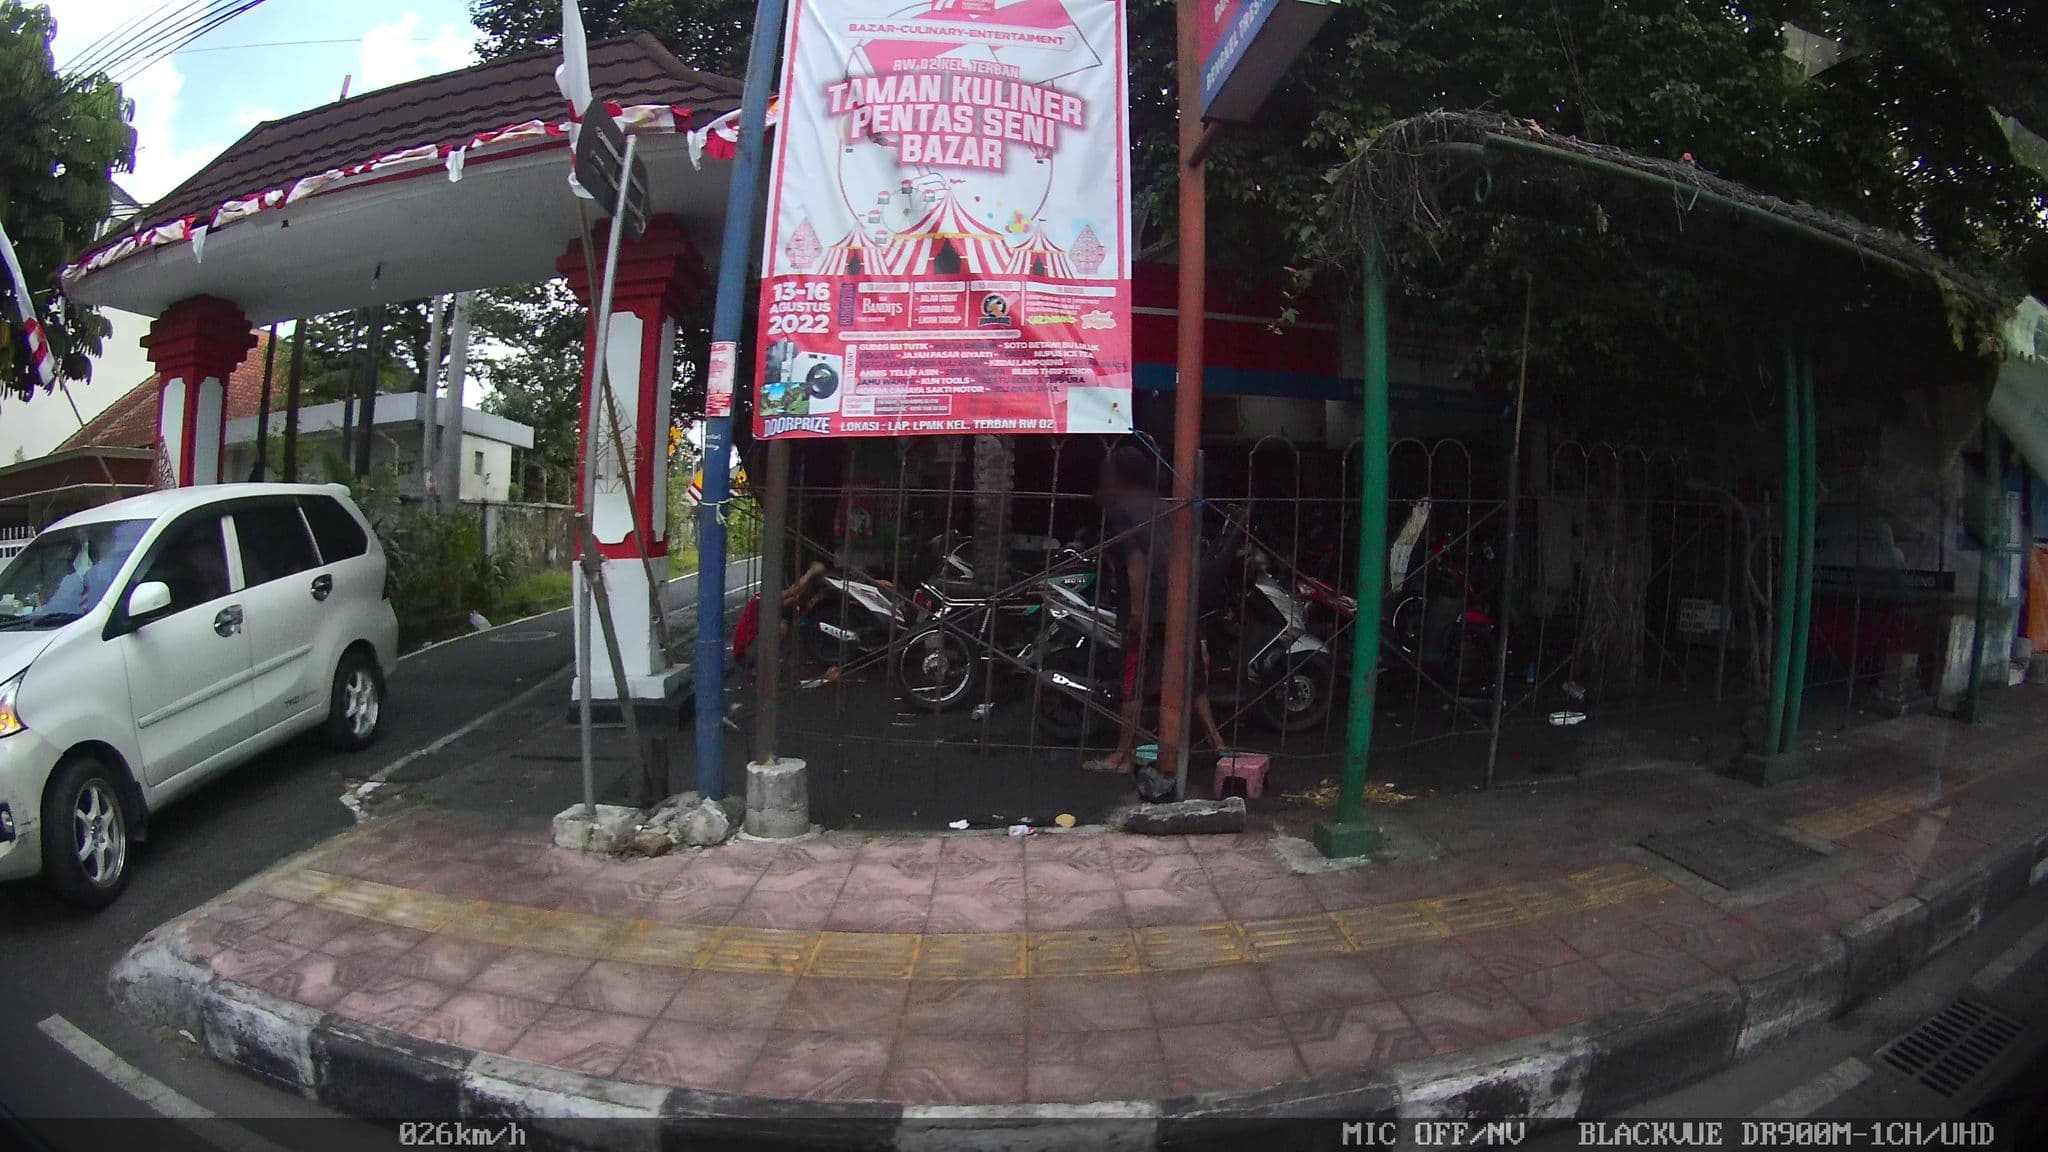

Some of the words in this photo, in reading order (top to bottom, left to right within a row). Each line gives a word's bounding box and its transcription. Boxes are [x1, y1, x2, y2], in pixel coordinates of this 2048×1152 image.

[848, 23, 1065, 45] BAZAR-CULINARY-ENTERTAIMENT
[969, 59, 1021, 78] TERBAN
[828, 75, 941, 113] TAMAN
[951, 77, 1082, 125] KULINER
[851, 103, 974, 138] PENTAS
[984, 109, 1055, 147] SENI
[901, 133, 1003, 168] BAZAR
[772, 281, 831, 301] 13-16
[769, 302, 832, 314] AGUSTUS
[767, 314, 829, 335] 2022
[763, 416, 831, 437] DOORPRIZE
[840, 421, 879, 431] LOKASI
[888, 421, 911, 431] LAP.
[912, 420, 945, 431] LPMK
[946, 419, 971, 430] KEL.
[973, 419, 1017, 429] TERBAN
[1019, 419, 1037, 429] RW
[1039, 418, 1054, 429] 02
